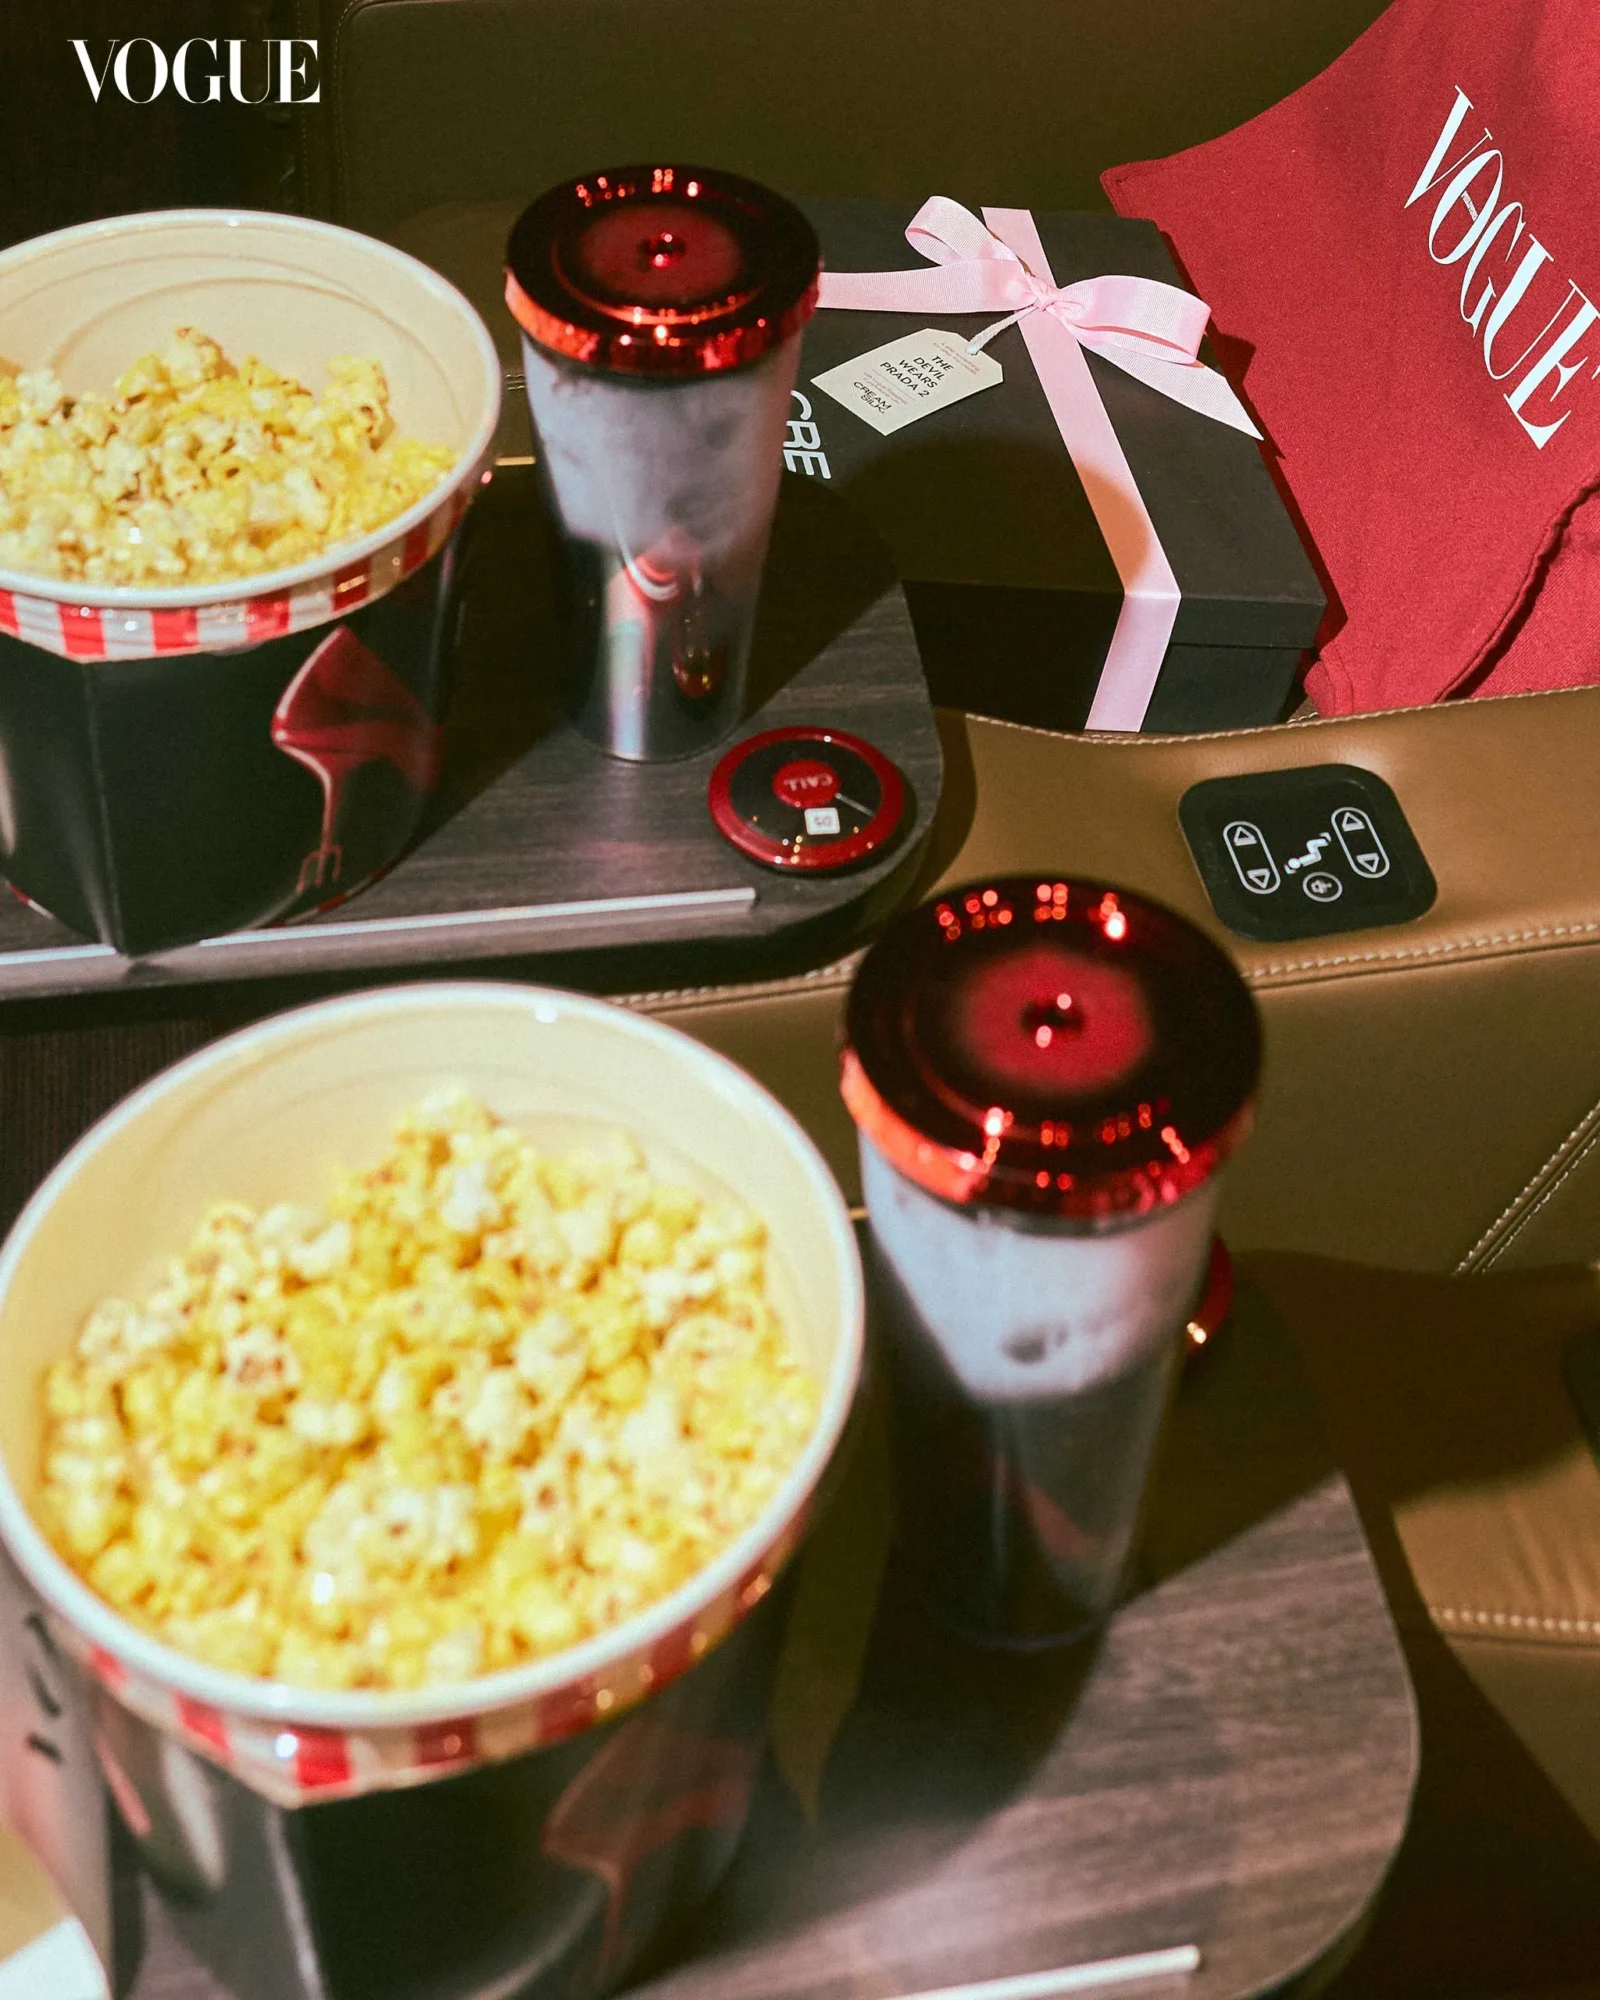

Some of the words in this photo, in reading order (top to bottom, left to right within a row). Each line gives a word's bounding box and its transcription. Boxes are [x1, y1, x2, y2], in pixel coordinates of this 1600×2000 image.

[1404, 85, 1600, 450] VOGUE
[899, 360, 938, 389] WEARS
[913, 357, 945, 380] DEVIL
[932, 356, 954, 371] THE
[880, 362, 918, 391] PRADA
[918, 390, 930, 398] 2
[853, 381, 892, 410] CREAM
[783, 773, 833, 792] CALL
